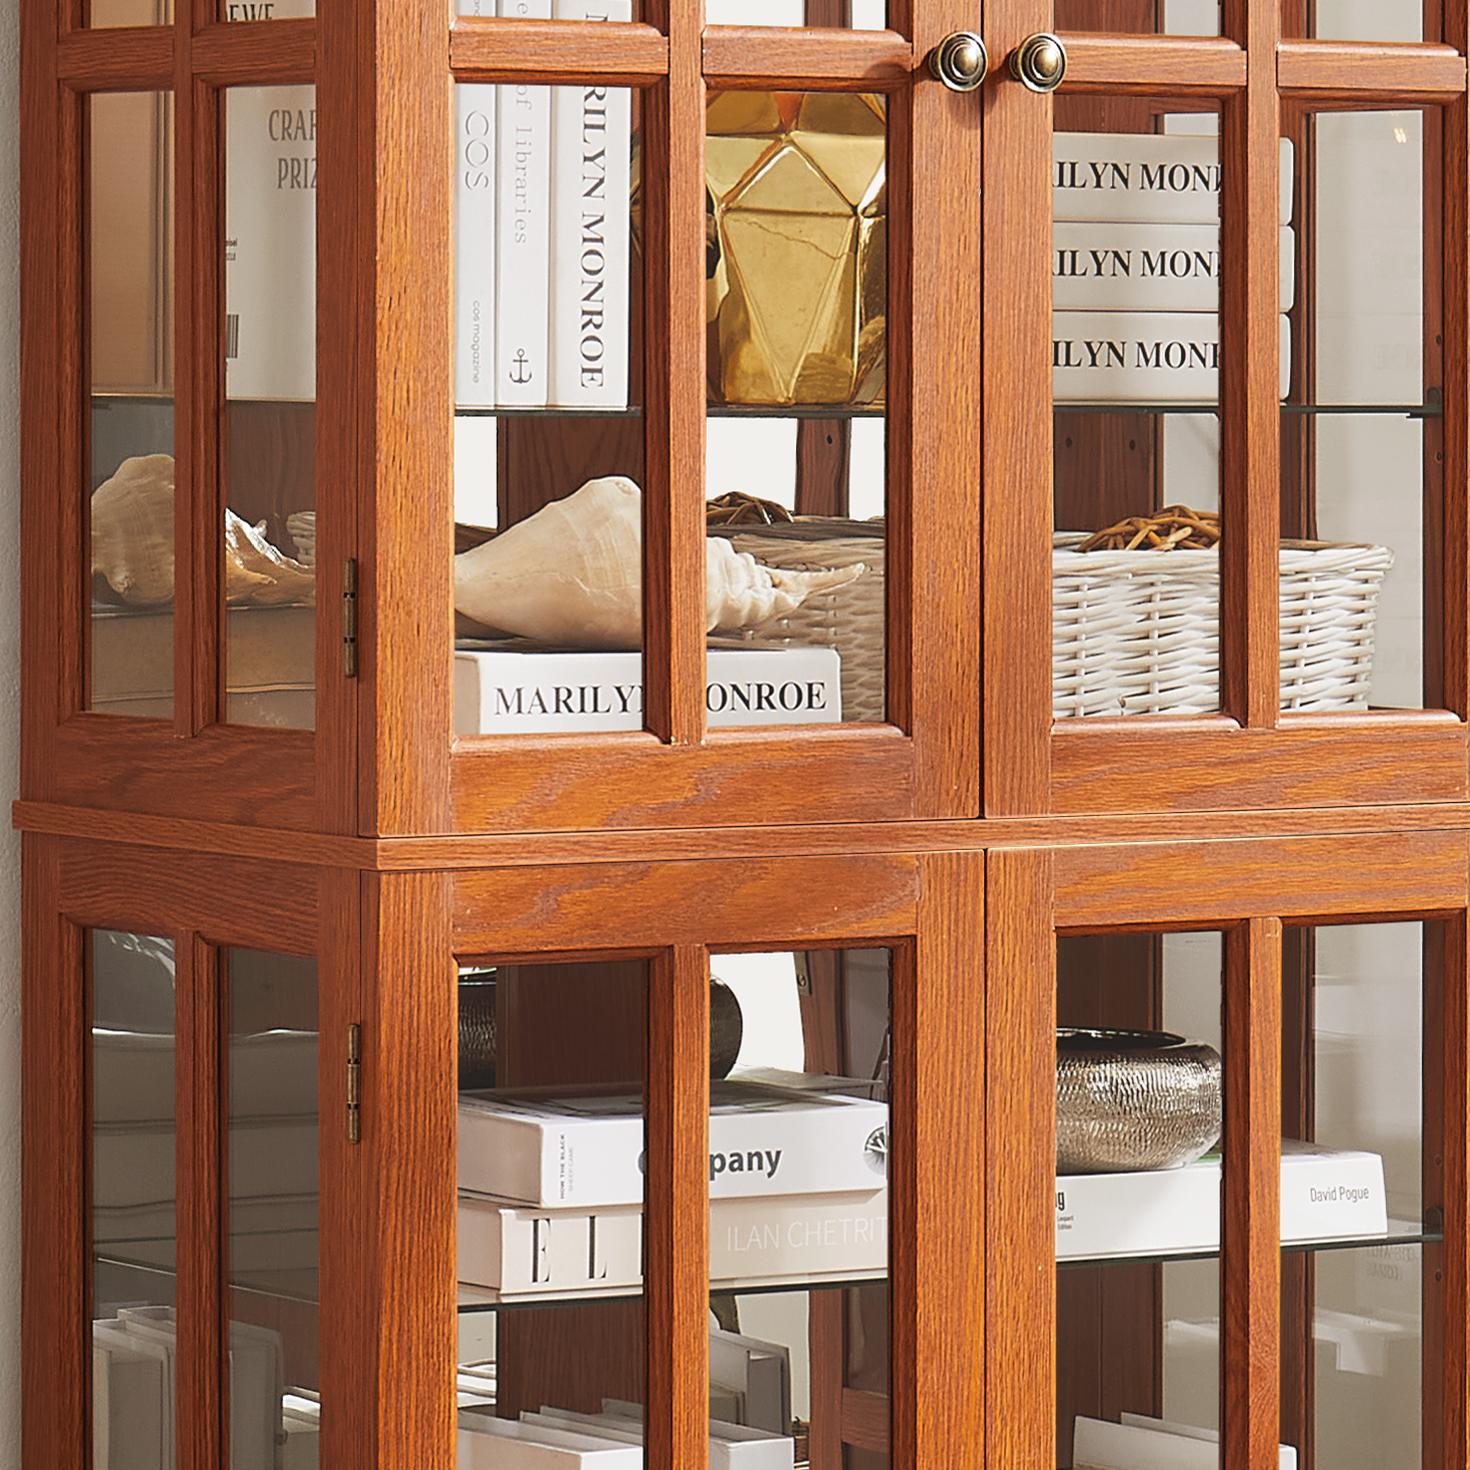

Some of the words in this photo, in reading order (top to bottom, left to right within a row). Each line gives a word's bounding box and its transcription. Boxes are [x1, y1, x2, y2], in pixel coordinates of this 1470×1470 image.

[465, 110, 489, 190] COS
[514, 127, 533, 244] libraries
[1053, 161, 1131, 190] ILYN
[1053, 249, 1132, 277] ILYN
[1140, 250, 1219, 278] MON
[579, 212, 606, 389] MONROE
[494, 683, 643, 716] MARILY
[706, 681, 828, 713] ONROE
[1310, 1186, 1337, 1202] David
[1339, 1185, 1369, 1203] Pogue
[727, 1223, 779, 1252] ILAN
